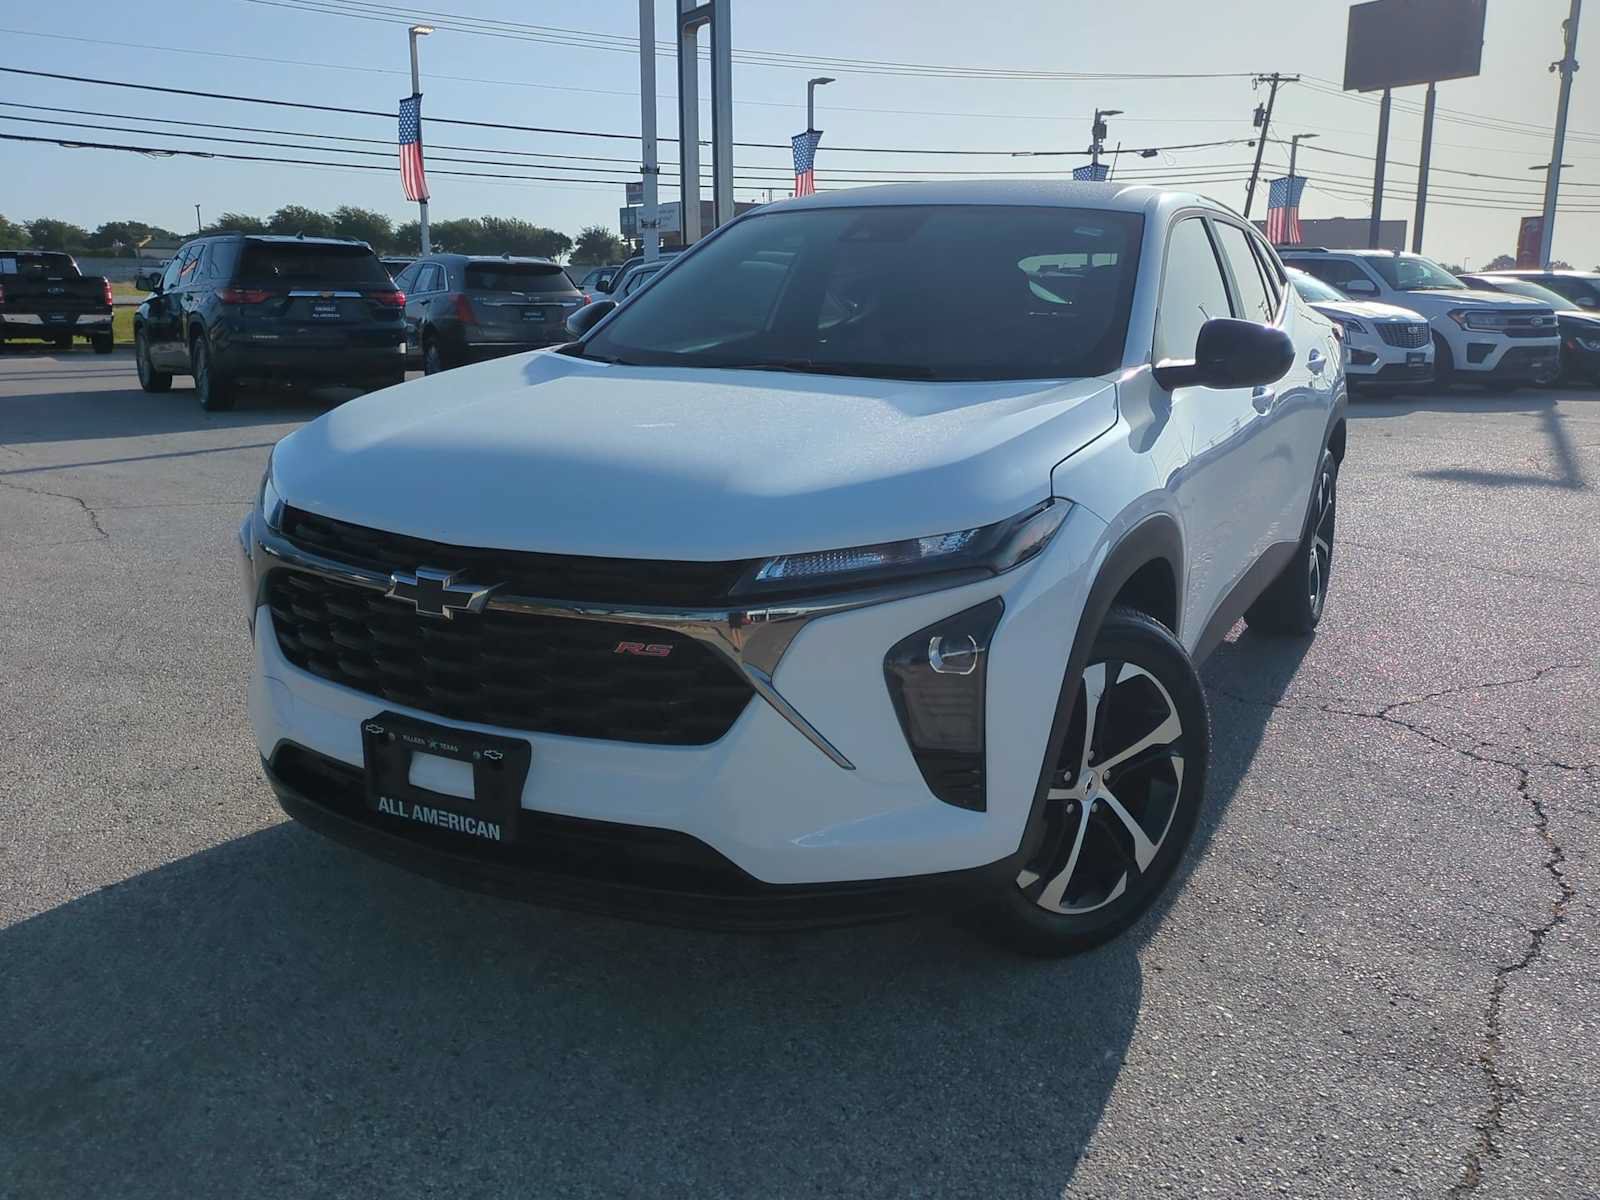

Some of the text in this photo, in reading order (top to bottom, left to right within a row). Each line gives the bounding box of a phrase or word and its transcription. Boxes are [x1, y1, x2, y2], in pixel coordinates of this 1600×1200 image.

[613, 641, 673, 657] RS
[440, 743, 459, 752] TEXAS
[378, 797, 500, 841] ALL AMERICAN
